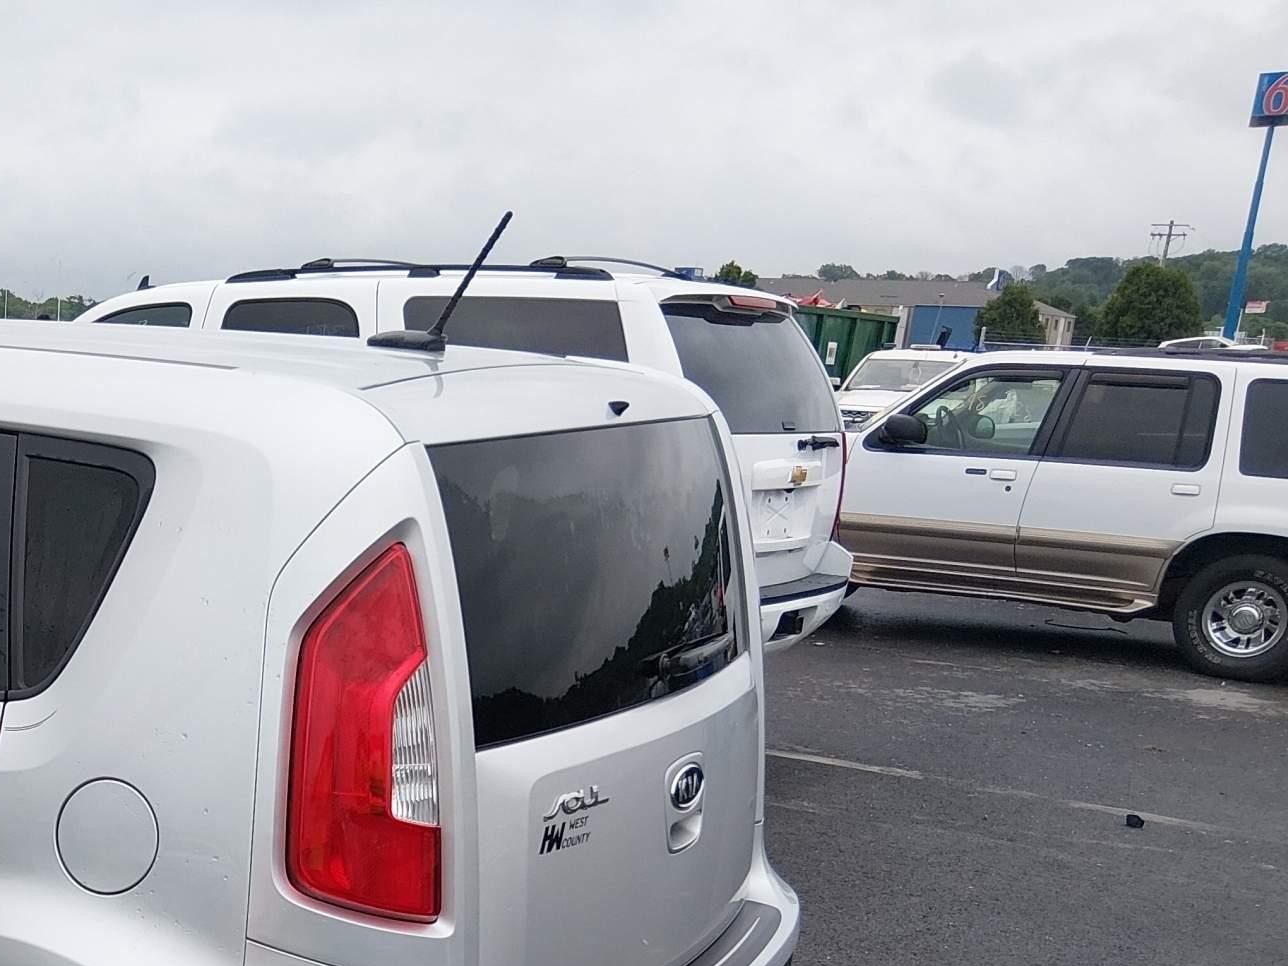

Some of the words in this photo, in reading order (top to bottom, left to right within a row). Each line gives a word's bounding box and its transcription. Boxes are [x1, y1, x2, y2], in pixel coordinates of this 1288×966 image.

[1262, 74, 1288, 116] 6
[678, 772, 700, 802] KIA
[569, 816, 589, 830] WEST
[561, 832, 591, 849] COUNTY
